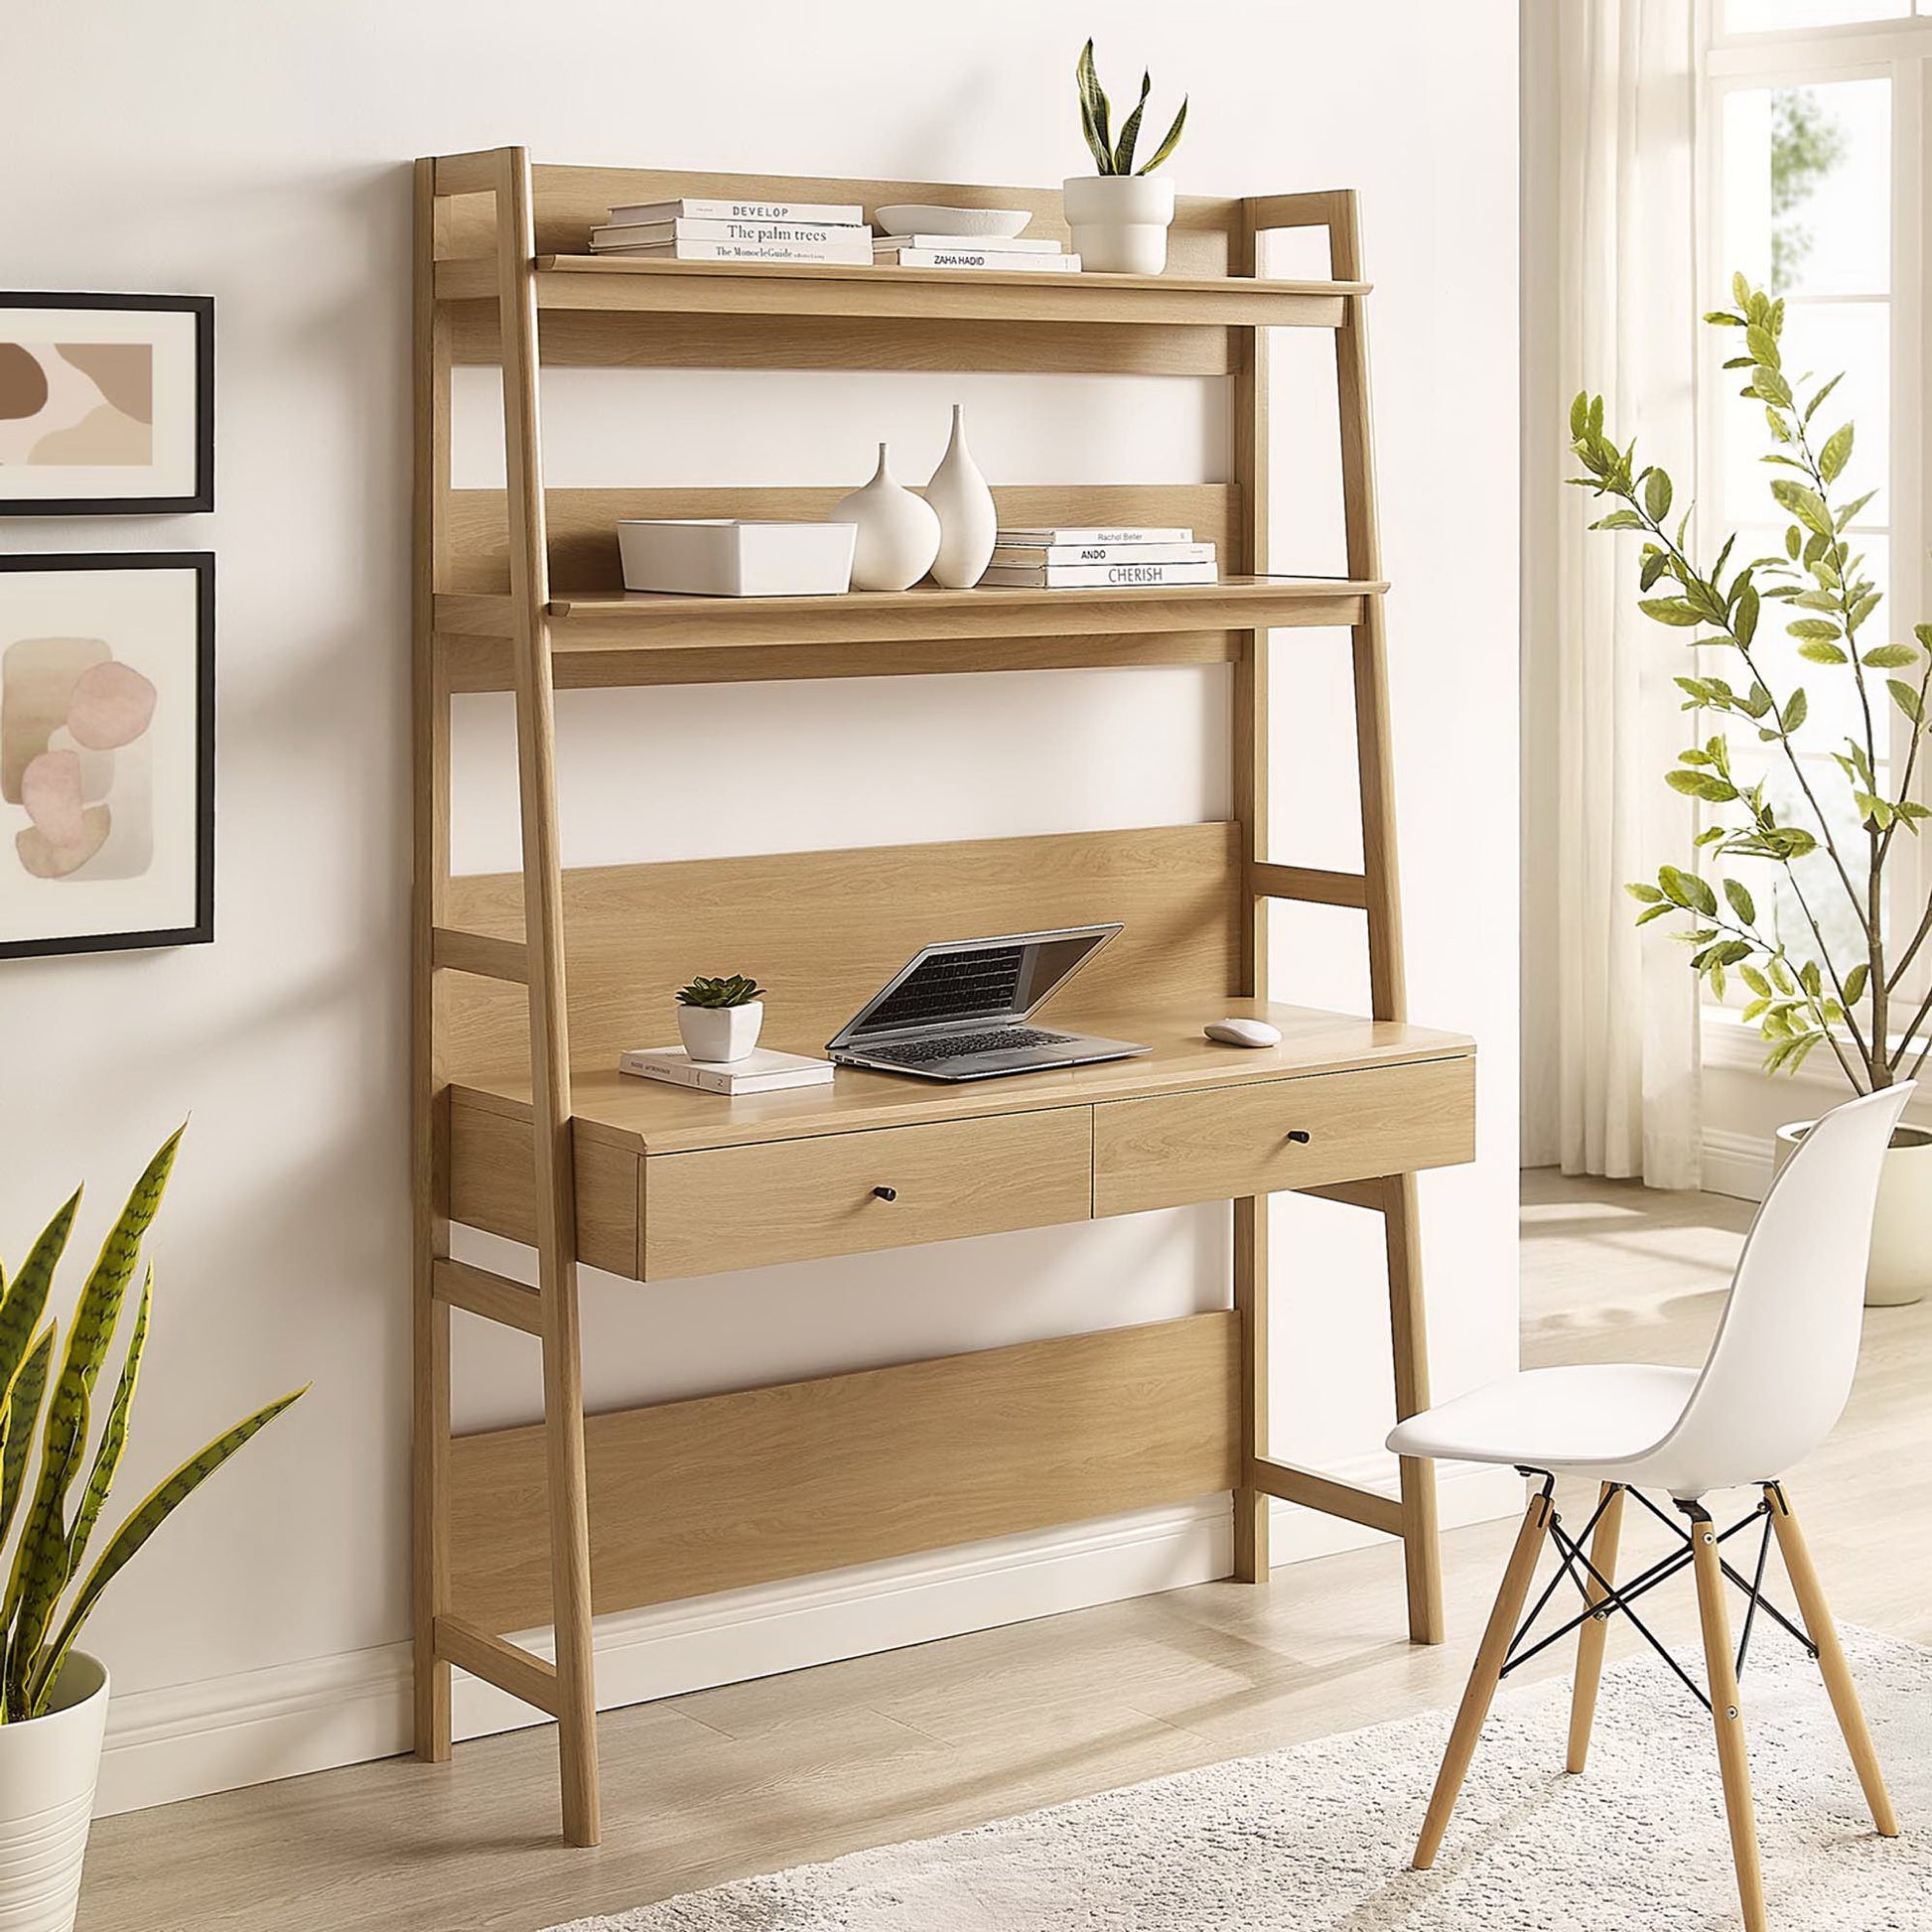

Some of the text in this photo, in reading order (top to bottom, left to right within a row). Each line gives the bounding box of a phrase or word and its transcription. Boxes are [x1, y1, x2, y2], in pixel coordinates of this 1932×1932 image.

[733, 206, 789, 217] DEVELOP
[727, 224, 827, 242] The palm trees
[716, 246, 733, 256] The
[934, 255, 957, 264] ZAHA
[1081, 550, 1106, 559] ANDO
[1108, 568, 1163, 583] CHERISH
